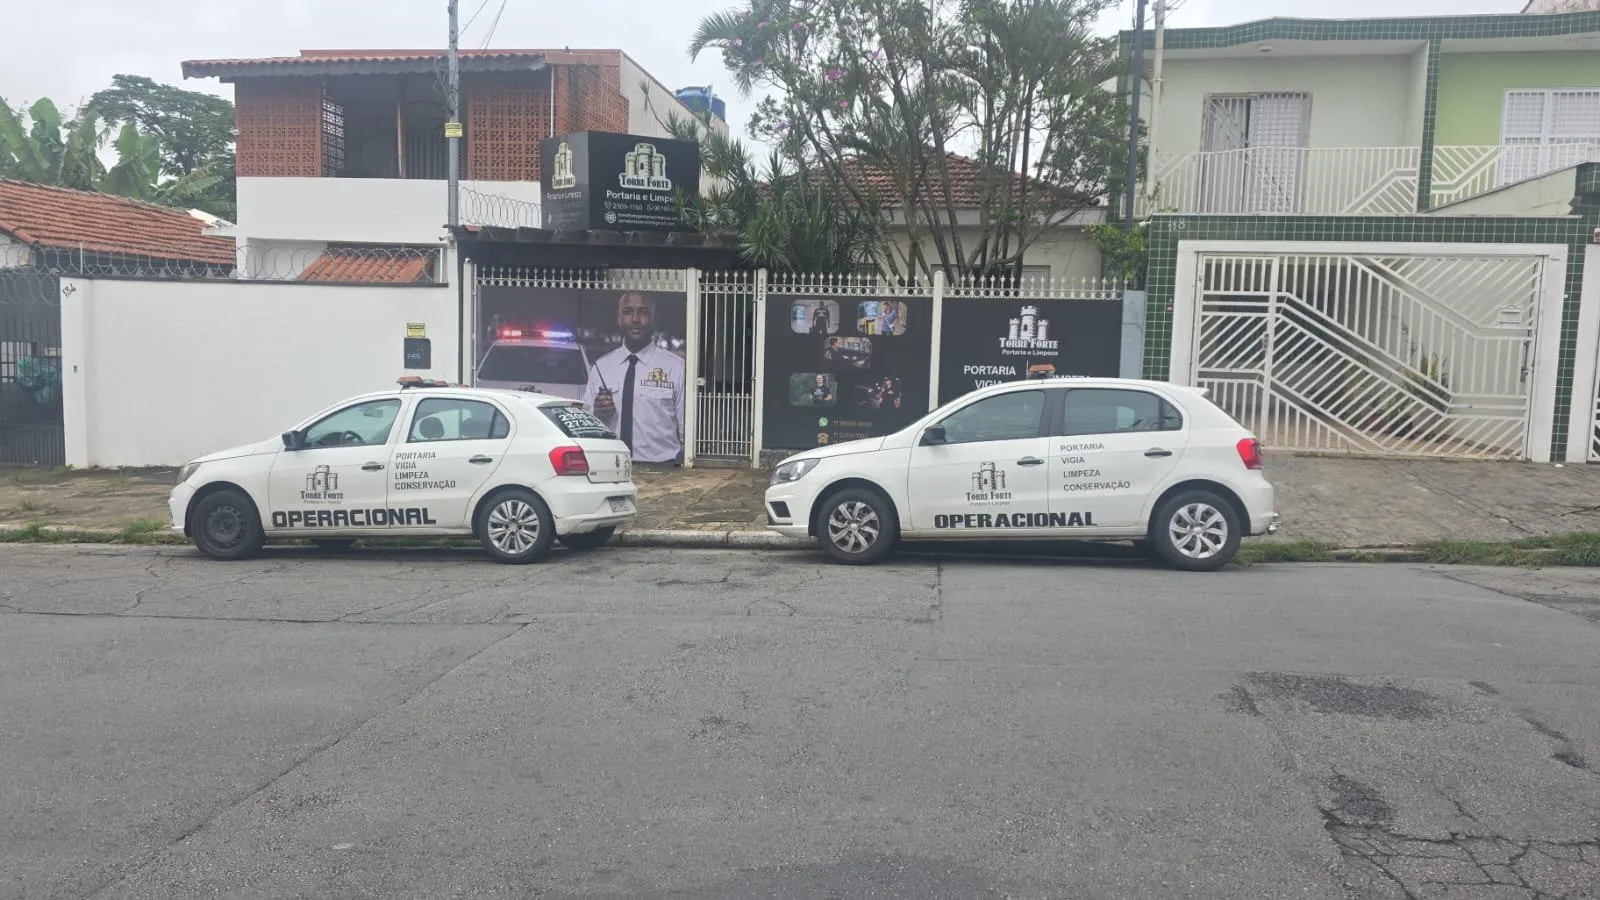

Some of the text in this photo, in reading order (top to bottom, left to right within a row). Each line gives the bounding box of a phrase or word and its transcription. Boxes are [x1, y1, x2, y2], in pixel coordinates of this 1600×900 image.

[621, 175, 669, 188] TORRE FORTE
[606, 190, 640, 200] Portaria
[650, 193, 675, 203] Limpe
[1167, 217, 1186, 232] 118
[999, 337, 1058, 349] TORRE FORTE
[963, 365, 1016, 376] PORTARIA
[1060, 443, 1104, 451] PORTARIA
[395, 452, 436, 460] PORTARIA
[1061, 456, 1085, 465] VIGIA
[395, 462, 417, 470] VIGIA
[394, 472, 429, 480] LIMPEZA
[1063, 469, 1100, 478] LIMPEZA
[394, 480, 456, 490] CONSERVAÇÃO
[1063, 480, 1131, 491] CONSERVAÇÃO
[300, 490, 344, 499] TORRE FORTE
[966, 491, 1011, 501] TORRE FORTE
[272, 508, 437, 527] OPERACIONAL
[934, 512, 1097, 529] OPERACIONAL
